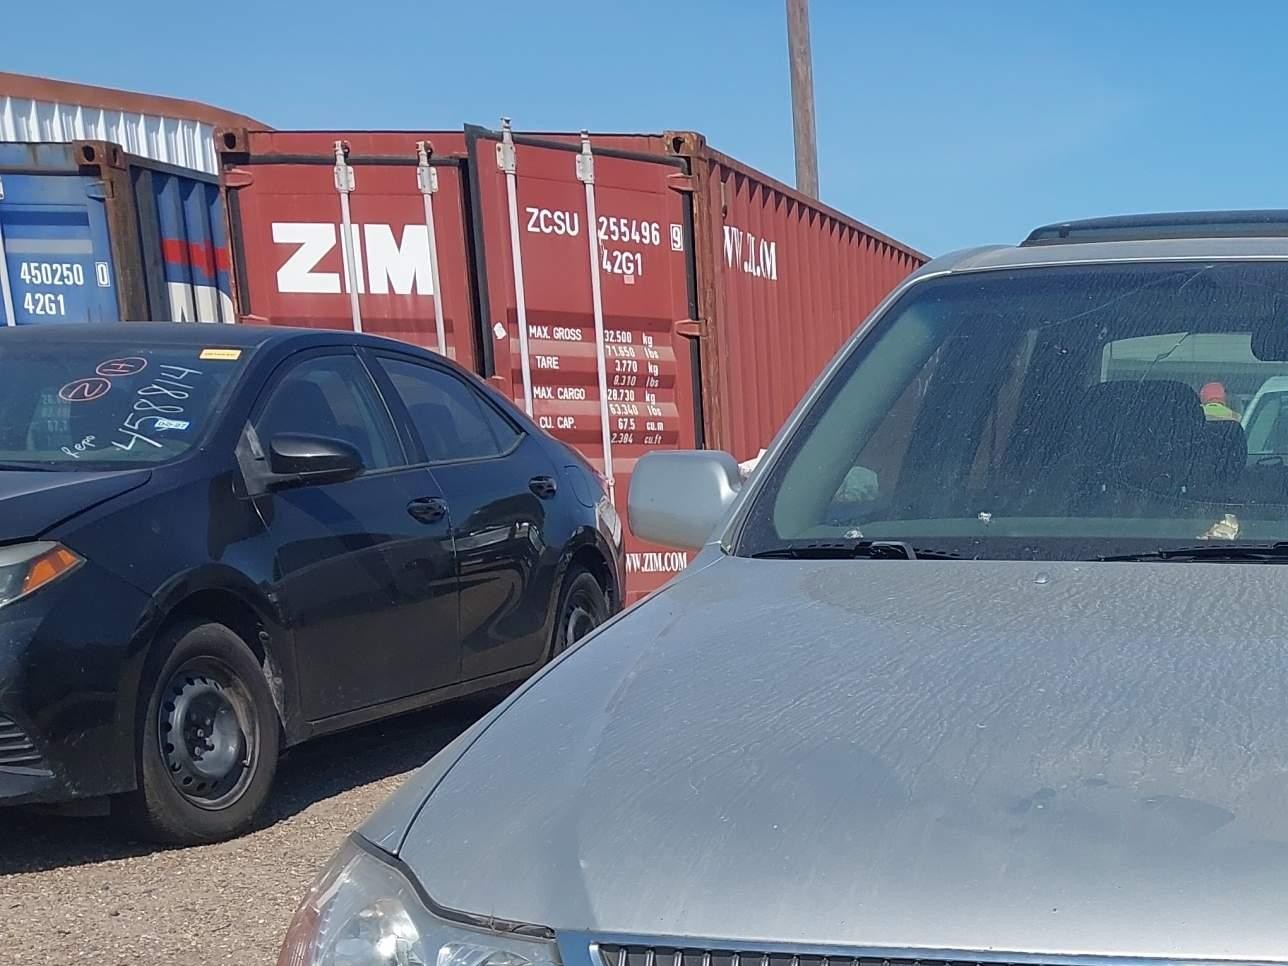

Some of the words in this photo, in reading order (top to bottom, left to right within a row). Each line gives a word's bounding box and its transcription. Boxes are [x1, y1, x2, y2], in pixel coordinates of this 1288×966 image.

[525, 207, 579, 236] ZCSU
[598, 216, 661, 246] 255496
[671, 226, 682, 250] 9
[272, 222, 434, 295] ZIM
[602, 249, 643, 277] 42G1
[20, 262, 84, 286] 450250
[97, 262, 109, 286] 0
[23, 293, 65, 315] 42G1
[529, 325, 550, 338] MAX.
[553, 328, 582, 341] GROSS
[604, 330, 632, 343] 32.500
[642, 333, 653, 347] kg
[644, 347, 659, 359] lbs
[536, 355, 559, 369] TARE
[615, 359, 638, 372] 3.770
[648, 361, 659, 376] kg
[646, 376, 659, 387] lbs
[533, 386, 554, 399] MAX.
[557, 388, 585, 400] CARGO
[607, 388, 635, 401] 28.730
[645, 390, 656, 404] kg
[647, 405, 662, 416] lbs
[539, 416, 554, 428] CU.
[557, 416, 577, 429] CAP.
[618, 418, 636, 430] 67.5
[646, 420, 664, 431] cu.m
